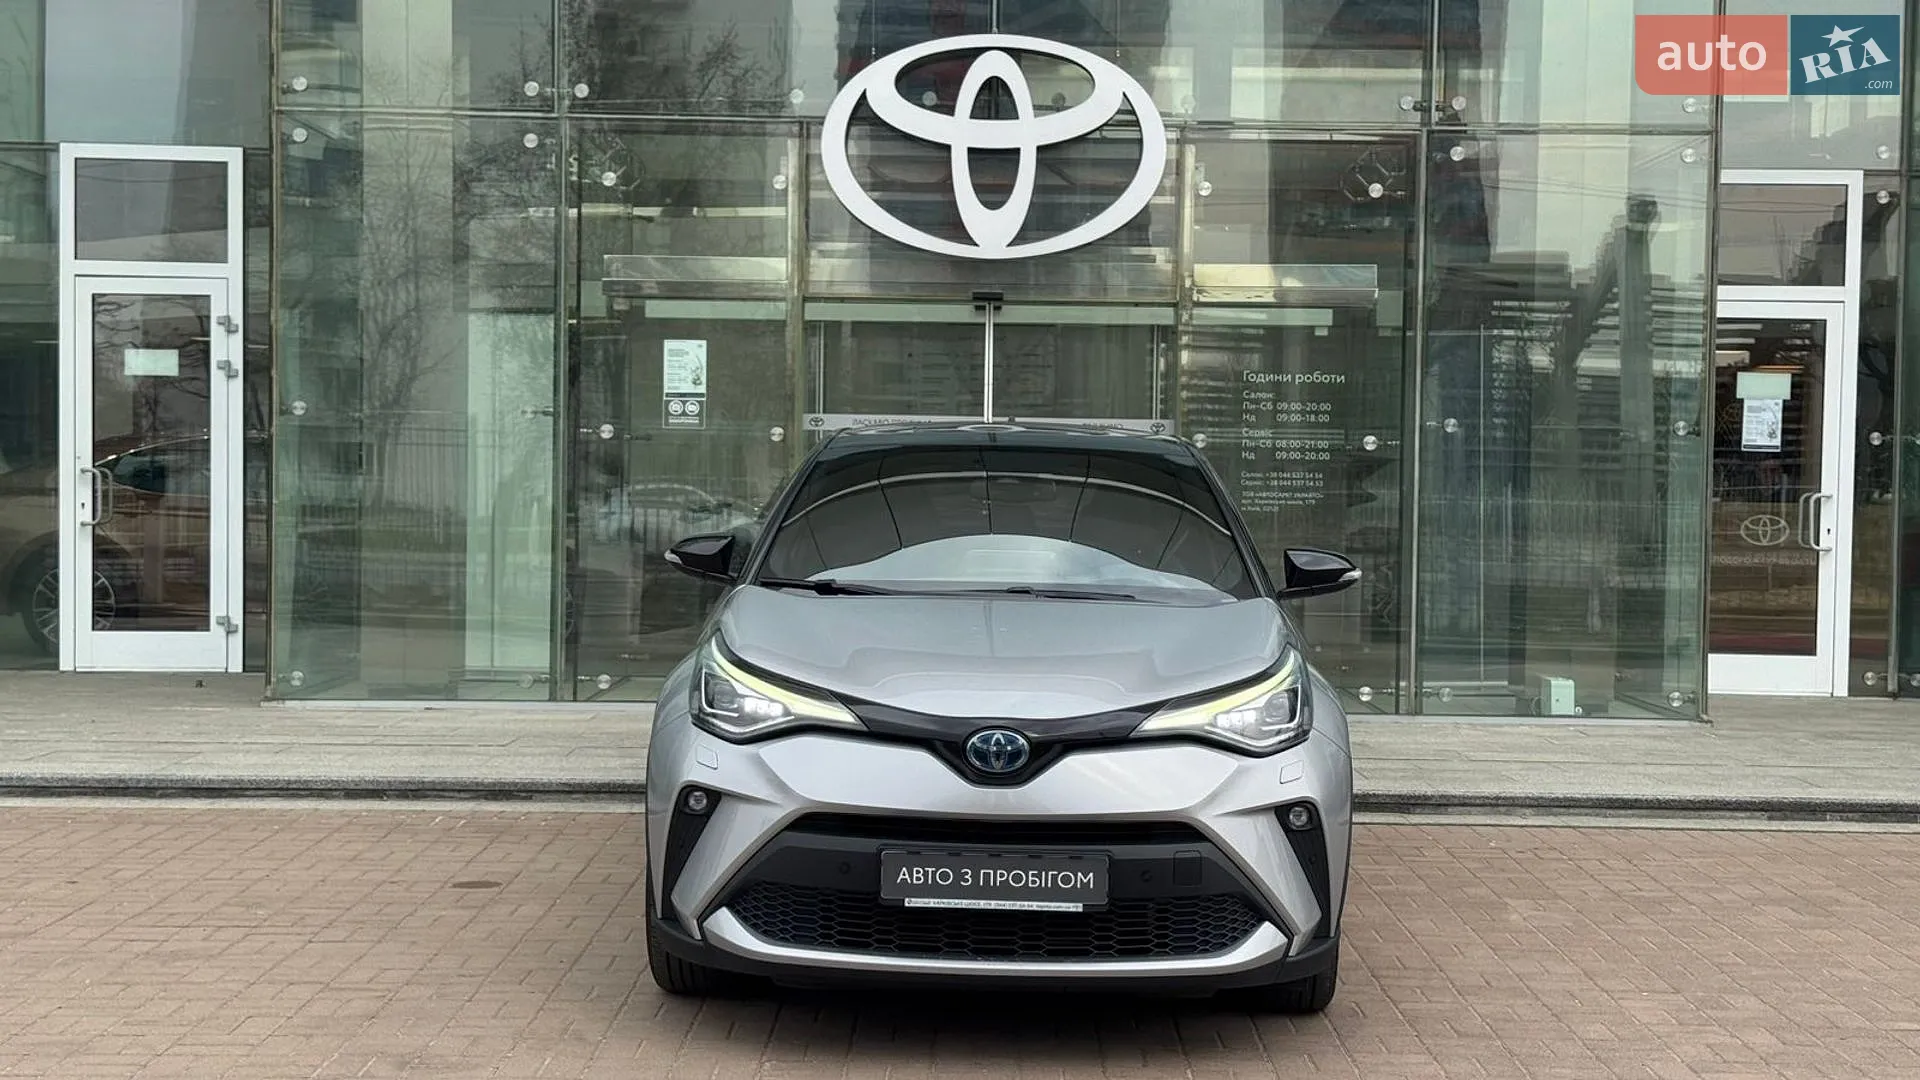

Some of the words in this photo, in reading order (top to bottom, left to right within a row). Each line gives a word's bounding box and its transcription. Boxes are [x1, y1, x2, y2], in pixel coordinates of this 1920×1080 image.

[1242, 370, 1292, 383] Години
[1295, 371, 1345, 384] роботи
[1242, 390, 1275, 399] Салон:
[1242, 401, 1273, 411] Пн-Сб
[1242, 413, 1257, 422] Нд
[1241, 439, 1272, 449] Пн-Сб
[1241, 451, 1256, 460] Нд
[896, 867, 954, 885] АВТО
[979, 869, 1095, 889] ПРОБІГОМ
